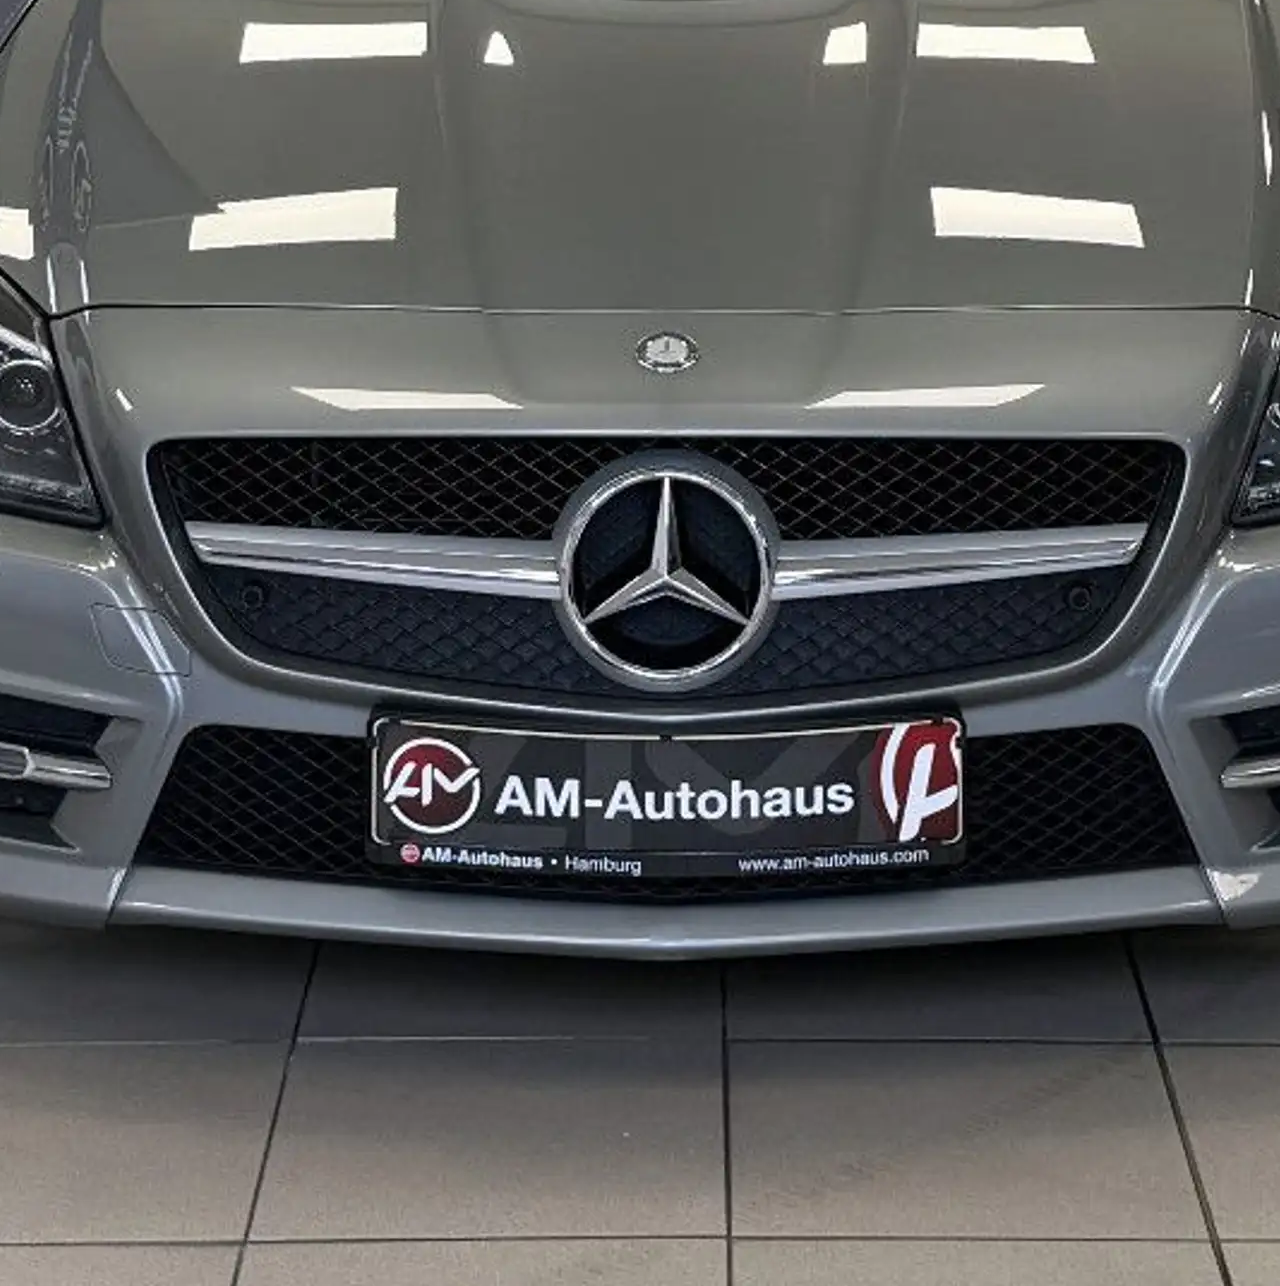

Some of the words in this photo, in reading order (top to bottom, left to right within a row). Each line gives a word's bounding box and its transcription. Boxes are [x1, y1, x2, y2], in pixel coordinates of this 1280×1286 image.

[494, 775, 855, 820] AM-Autohaus
[421, 846, 543, 869] AM-Autohaus
[564, 854, 642, 876] Hamburg
[738, 848, 930, 872] www.am-autohaus.com
